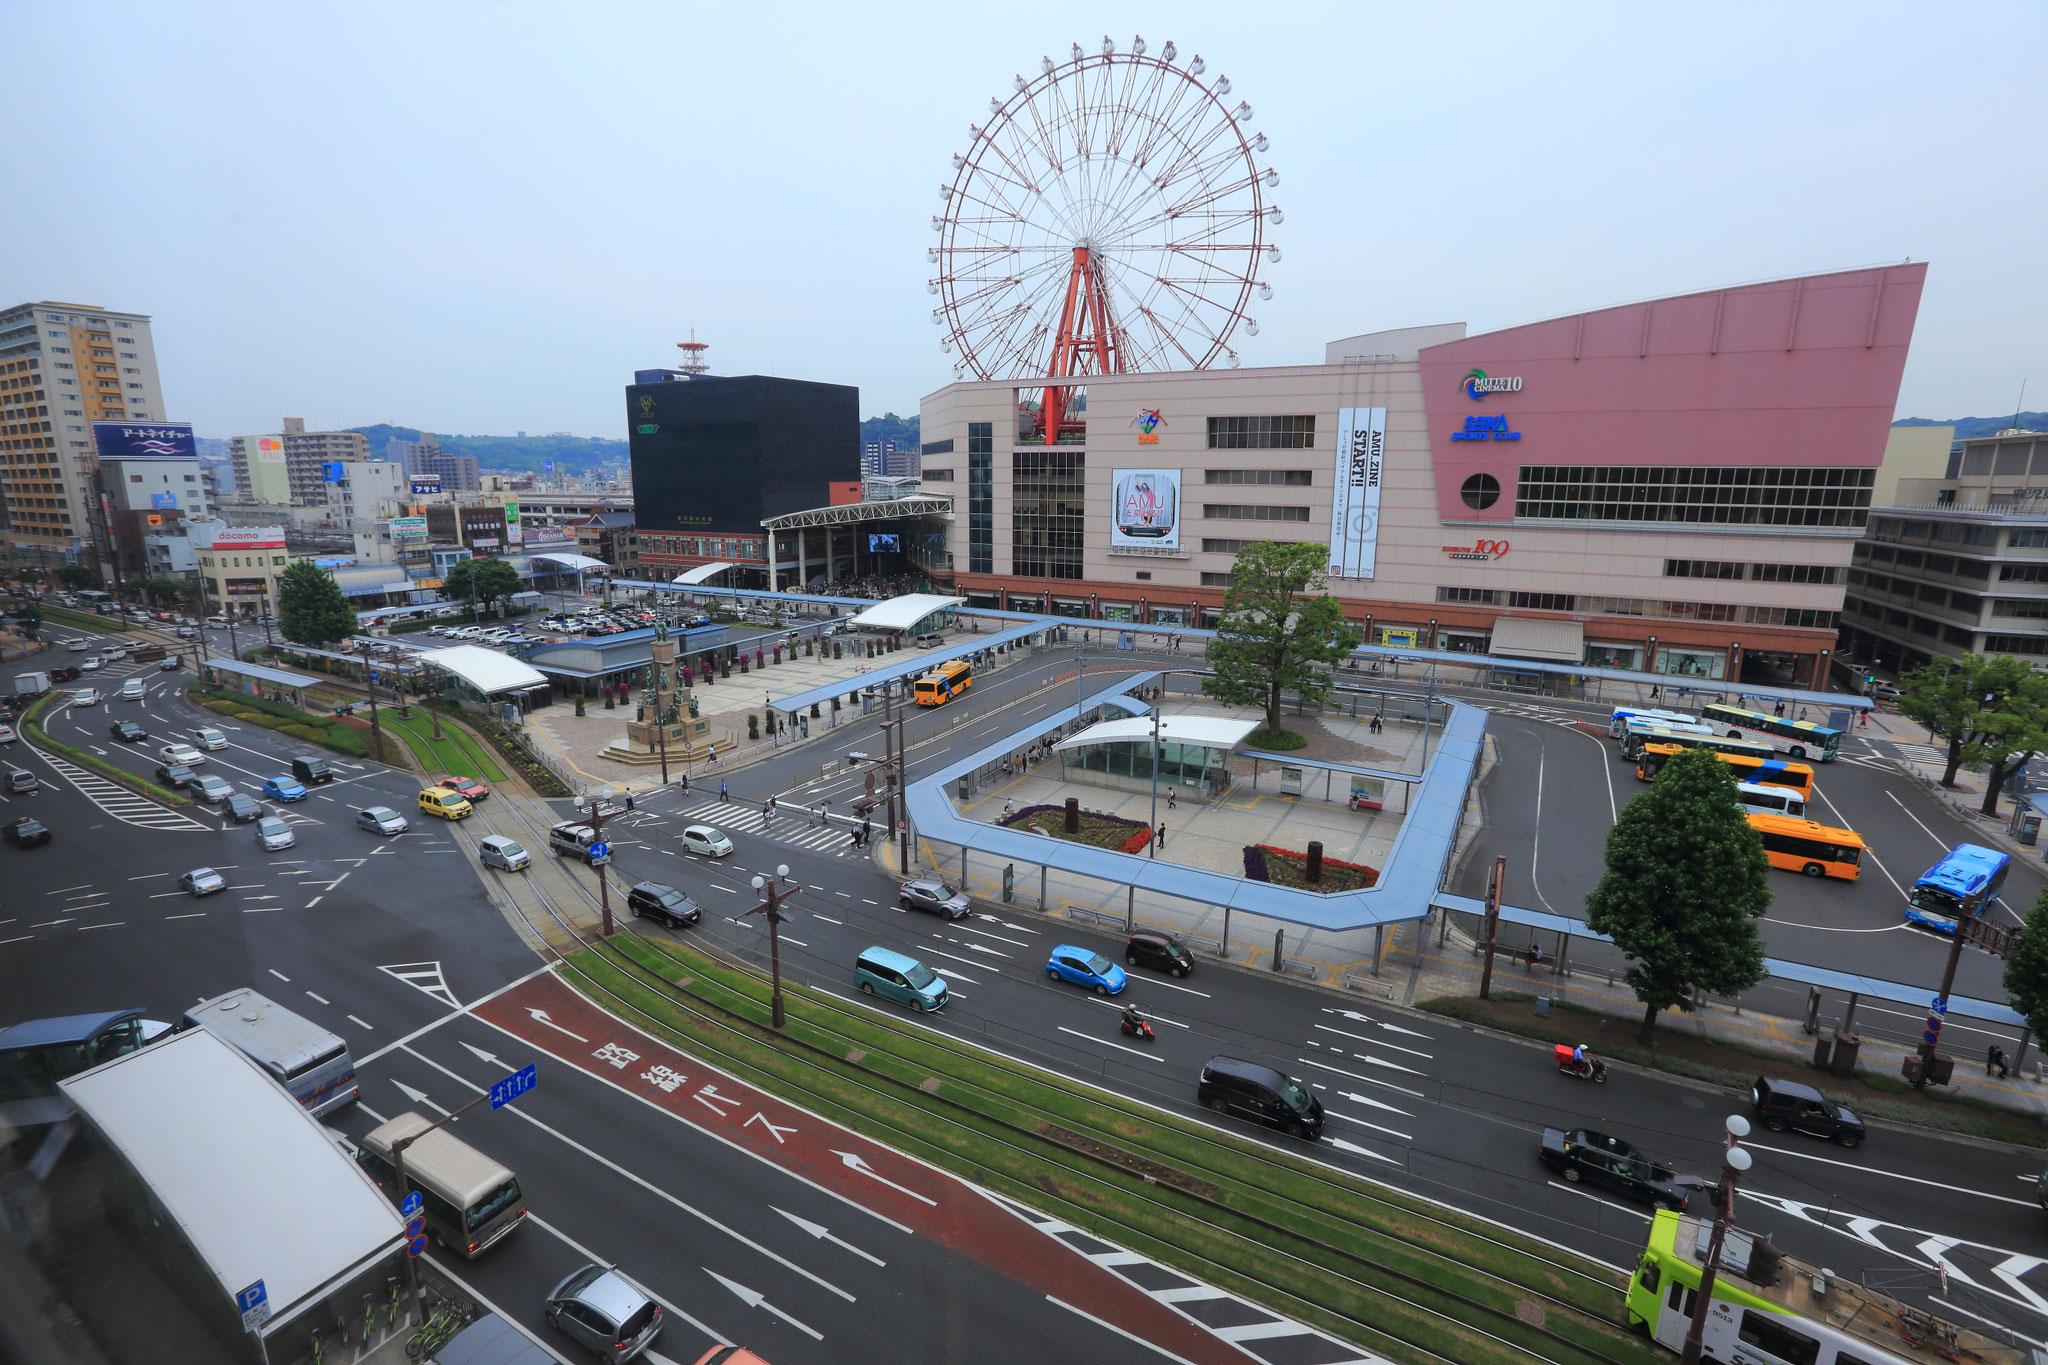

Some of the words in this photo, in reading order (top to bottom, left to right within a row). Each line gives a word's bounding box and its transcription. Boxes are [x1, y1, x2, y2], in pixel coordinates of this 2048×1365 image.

[1474, 377, 1506, 386] MITTE
[1474, 385, 1505, 393] CINEMA
[1505, 376, 1523, 392] 10
[122, 428, 191, 438] アートネイチャー
[1451, 432, 1490, 441] SPORTS
[1492, 432, 1521, 440] CLUB
[1351, 430, 1368, 487] START!!
[1368, 430, 1382, 487] AMU_ZINE
[1126, 494, 1164, 509] AMU
[218, 531, 259, 540] docomo
[1472, 539, 1510, 560] 109
[1712, 1309, 1733, 1324] 9513
